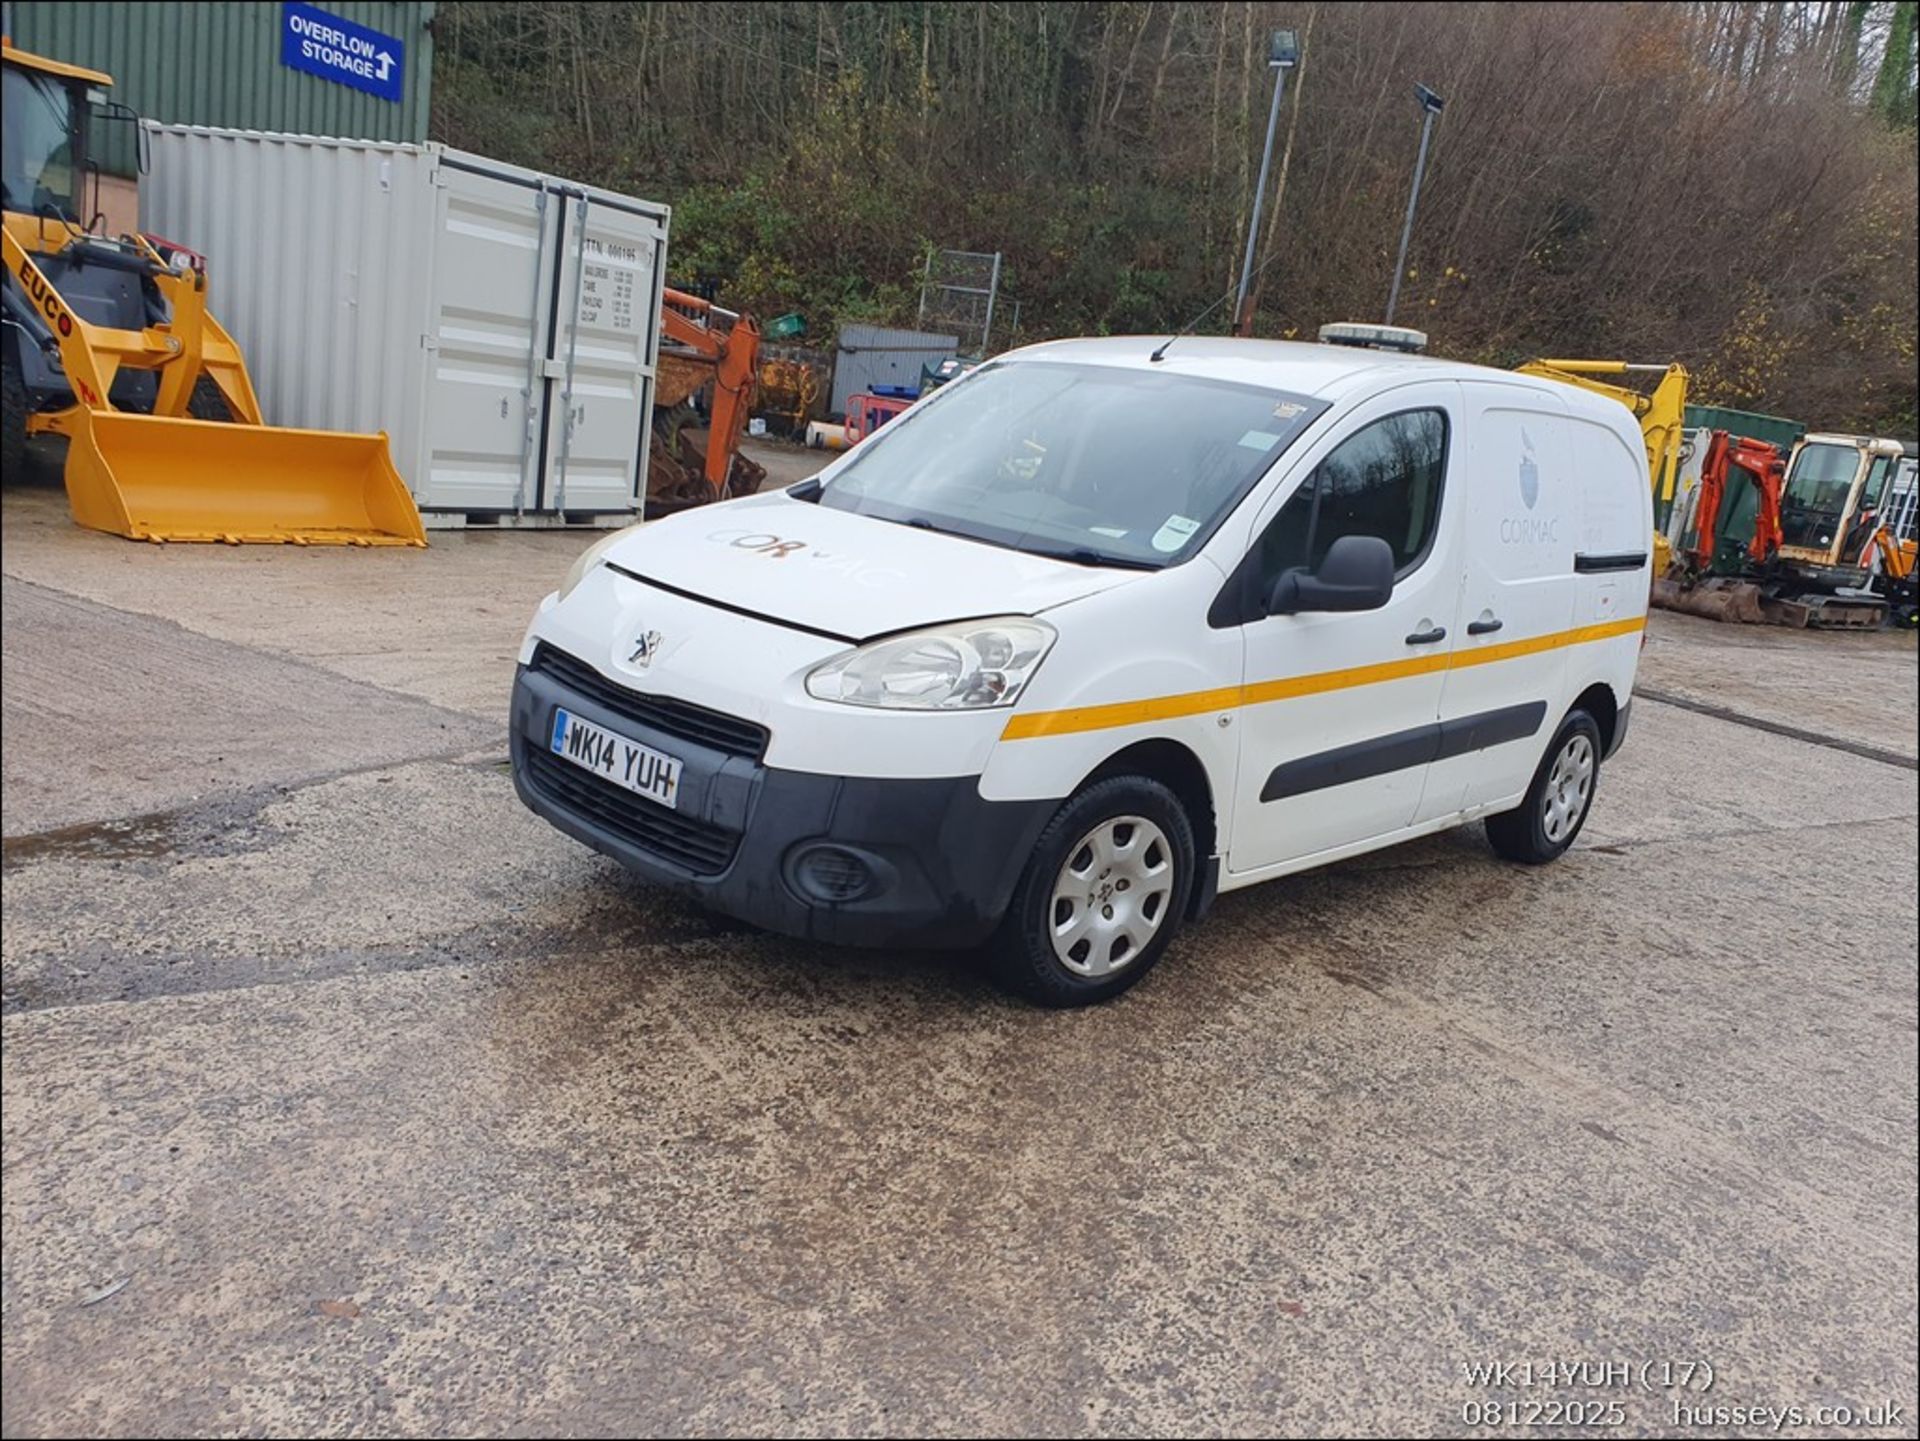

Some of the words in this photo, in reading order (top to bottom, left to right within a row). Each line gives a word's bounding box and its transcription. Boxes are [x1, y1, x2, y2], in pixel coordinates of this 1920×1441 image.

[290, 15, 375, 59] OVERFLOW
[302, 39, 374, 79] STORAGE
[1500, 518, 1559, 544] CORMAC
[568, 721, 616, 773] WK14
[624, 745, 672, 798] YUH
